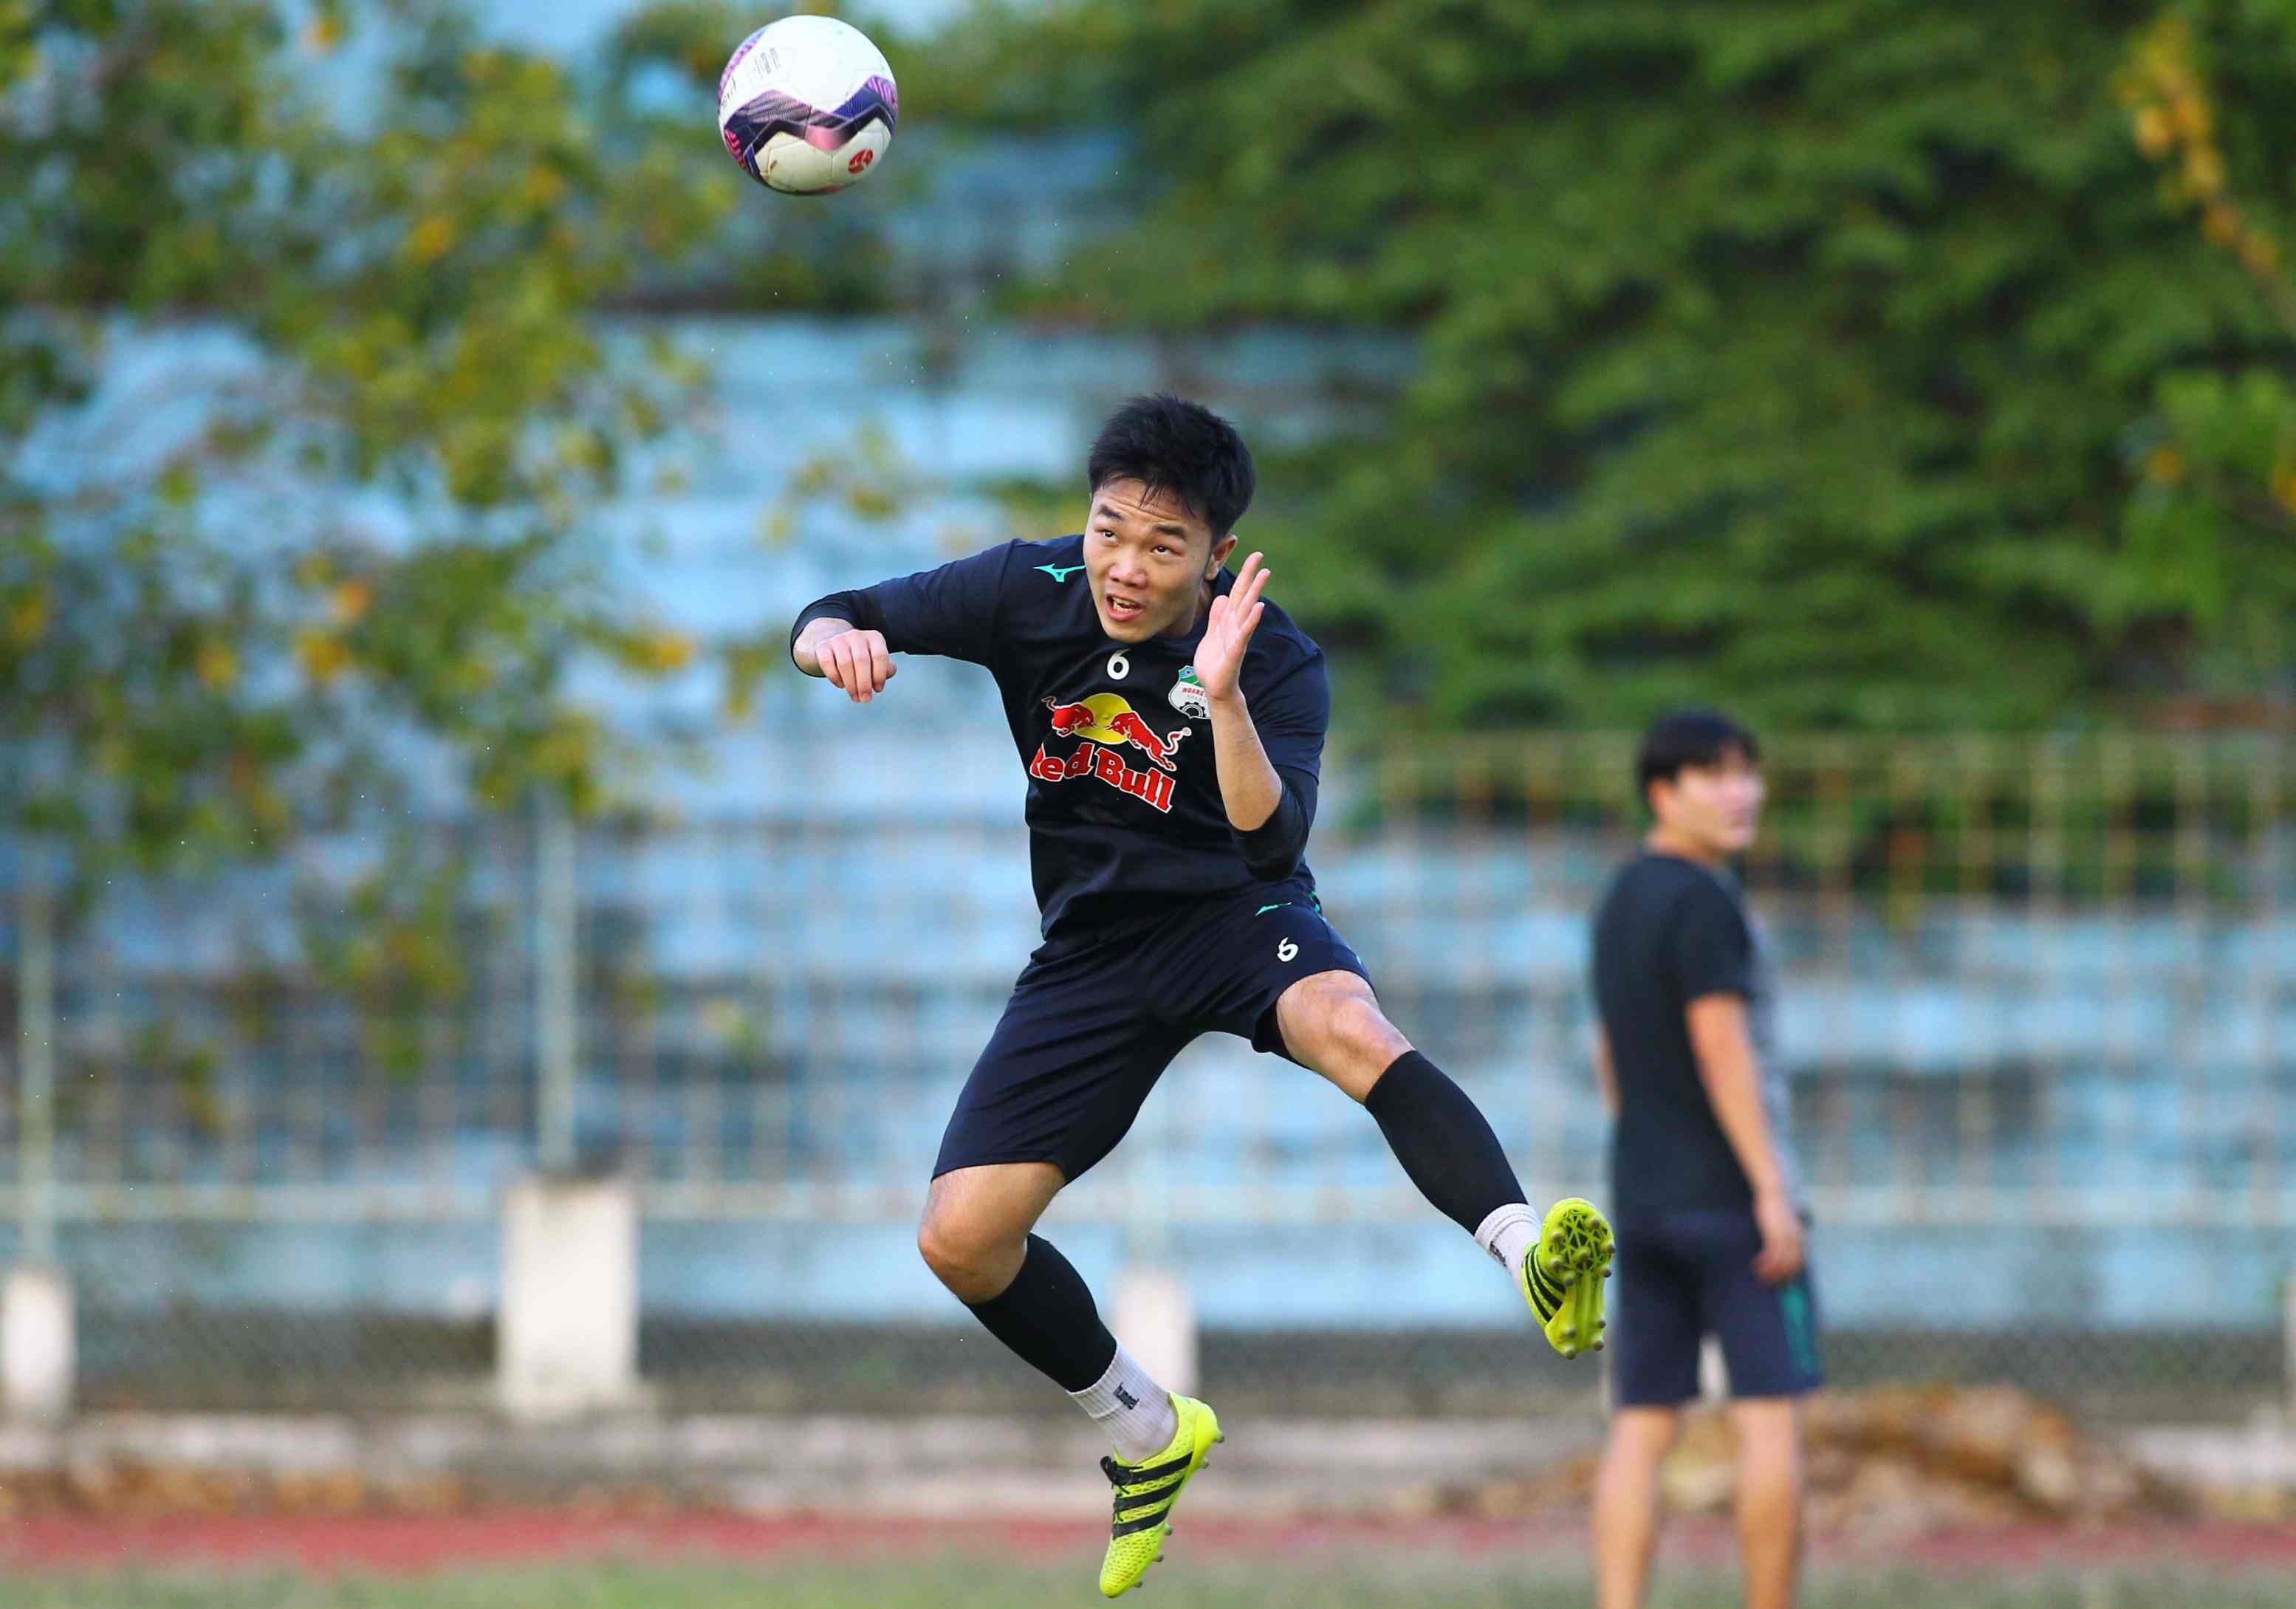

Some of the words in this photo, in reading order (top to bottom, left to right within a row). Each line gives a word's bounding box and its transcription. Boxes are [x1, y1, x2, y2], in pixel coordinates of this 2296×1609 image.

[1107, 649, 1129, 680] 6
[1094, 747, 1176, 813] Bull
[1276, 936, 1298, 962] 6
